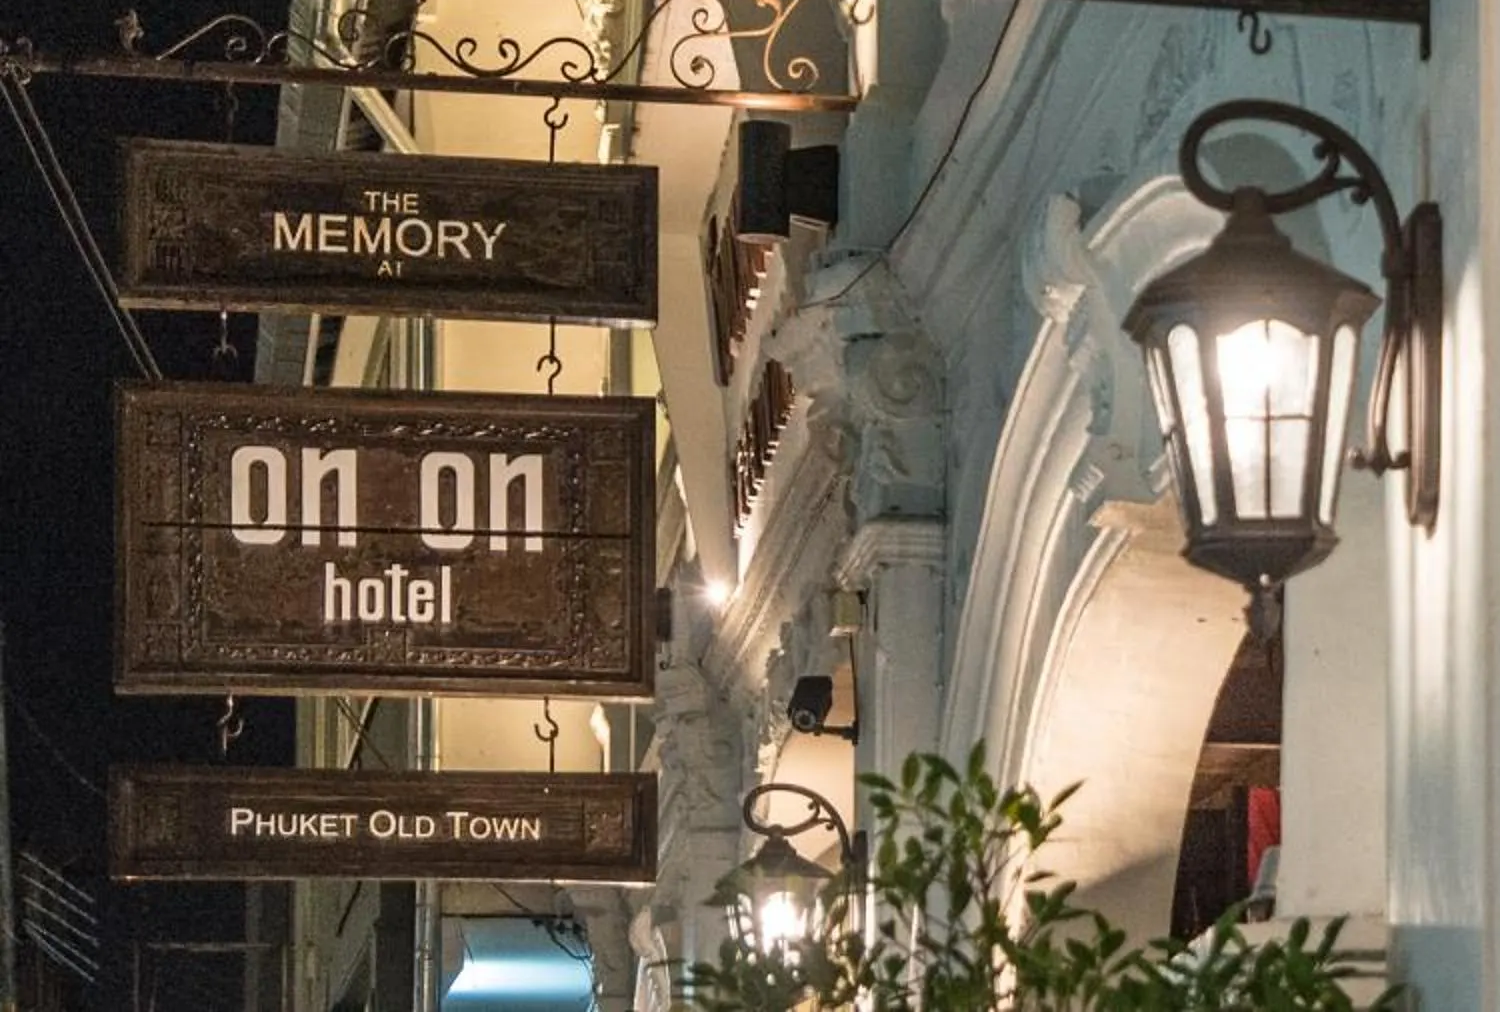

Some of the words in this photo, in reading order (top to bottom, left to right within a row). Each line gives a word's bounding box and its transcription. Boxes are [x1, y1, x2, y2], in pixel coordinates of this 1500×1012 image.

[364, 191, 420, 214] THE
[273, 212, 507, 261] MEMORY
[230, 445, 357, 548] on
[420, 451, 543, 552] on
[323, 561, 452, 624] hotel
[230, 808, 358, 837] PHUKET
[368, 809, 435, 839] OLD
[446, 811, 542, 841] TOWN
